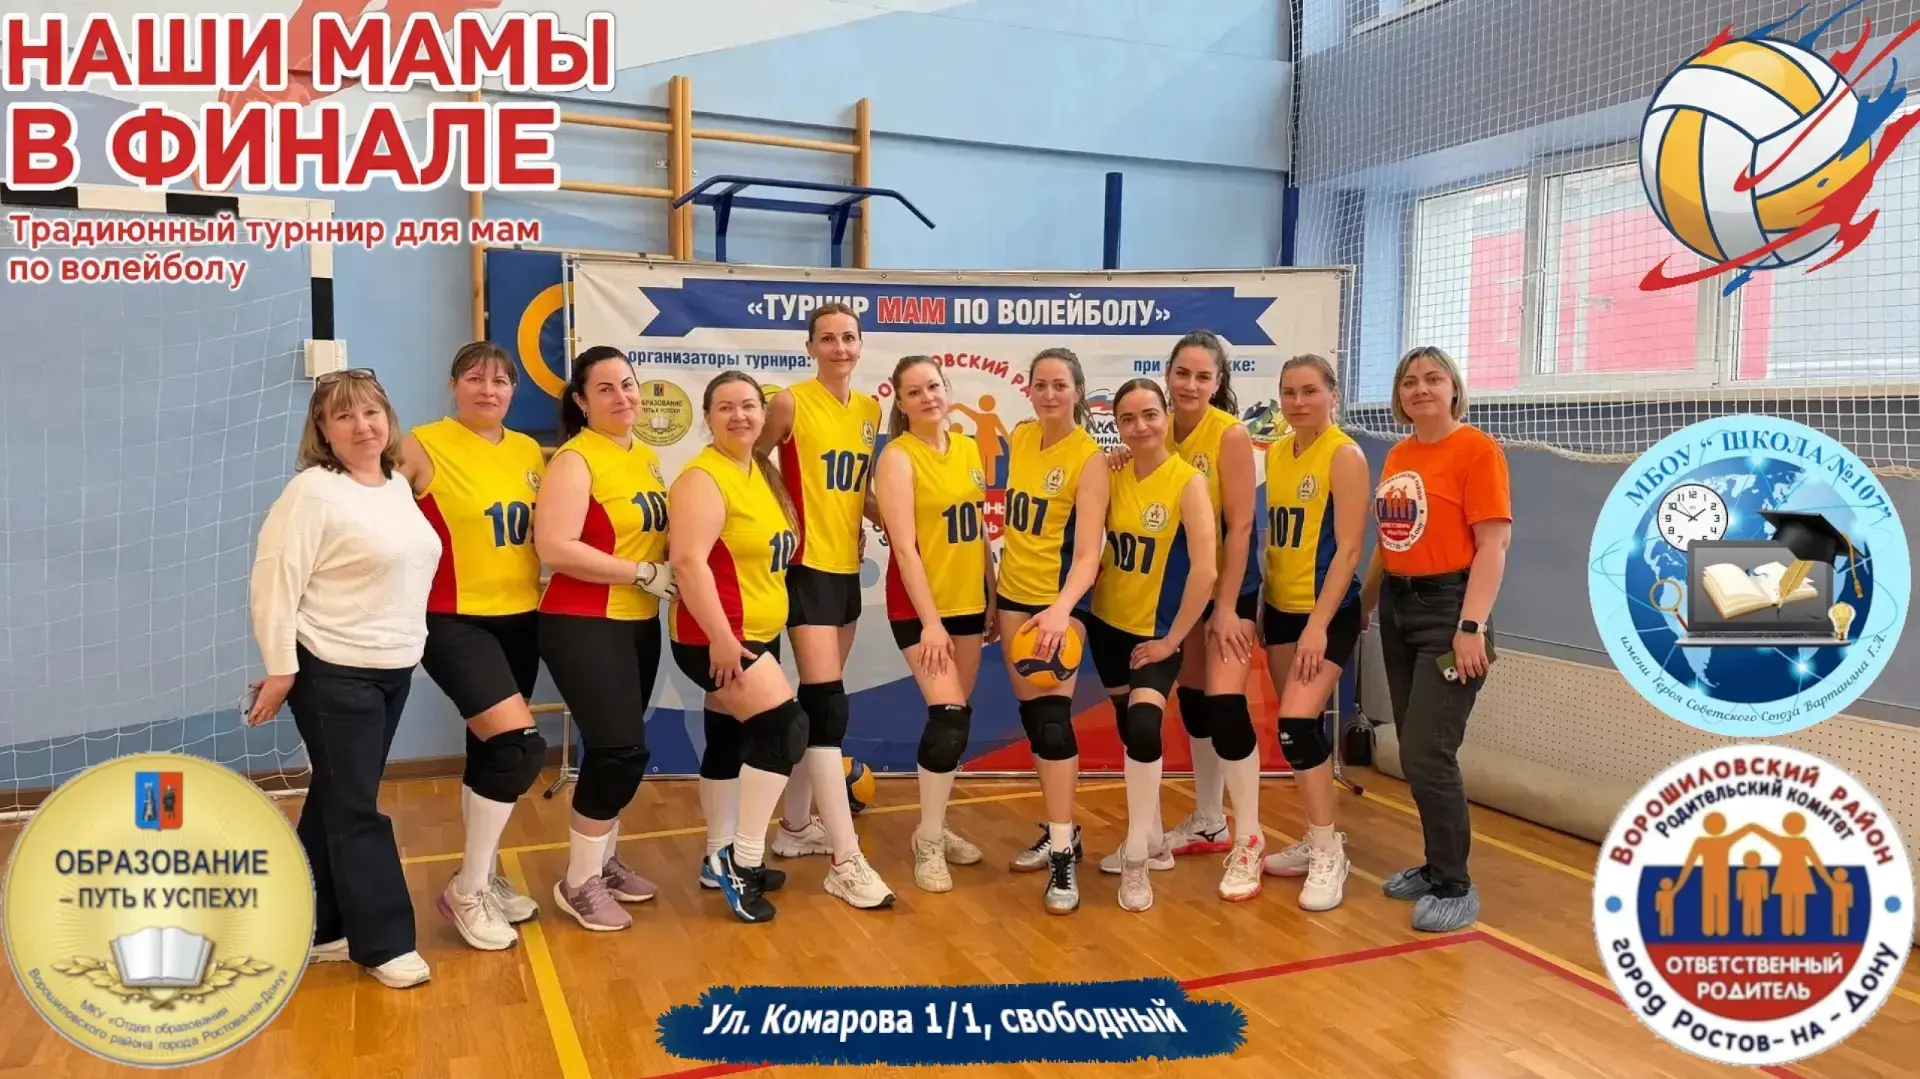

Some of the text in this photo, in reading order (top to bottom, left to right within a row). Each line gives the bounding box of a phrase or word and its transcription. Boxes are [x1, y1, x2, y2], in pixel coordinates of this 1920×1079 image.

[877, 296, 946, 324] МАМ
[954, 298, 989, 325] ПО
[997, 292, 1171, 326] ВОЛЕЙБОЛУ»
[628, 350, 811, 370] организаторы турнира:
[1133, 360, 1160, 375] при
[640, 399, 683, 407] БРАЗОВАНИЕ
[820, 449, 870, 492] 107
[483, 501, 536, 548] 10
[631, 491, 668, 532] 10
[1005, 488, 1048, 536] 107
[1268, 506, 1305, 548] 107
[769, 529, 796, 573] 10
[1107, 530, 1155, 575] 107
